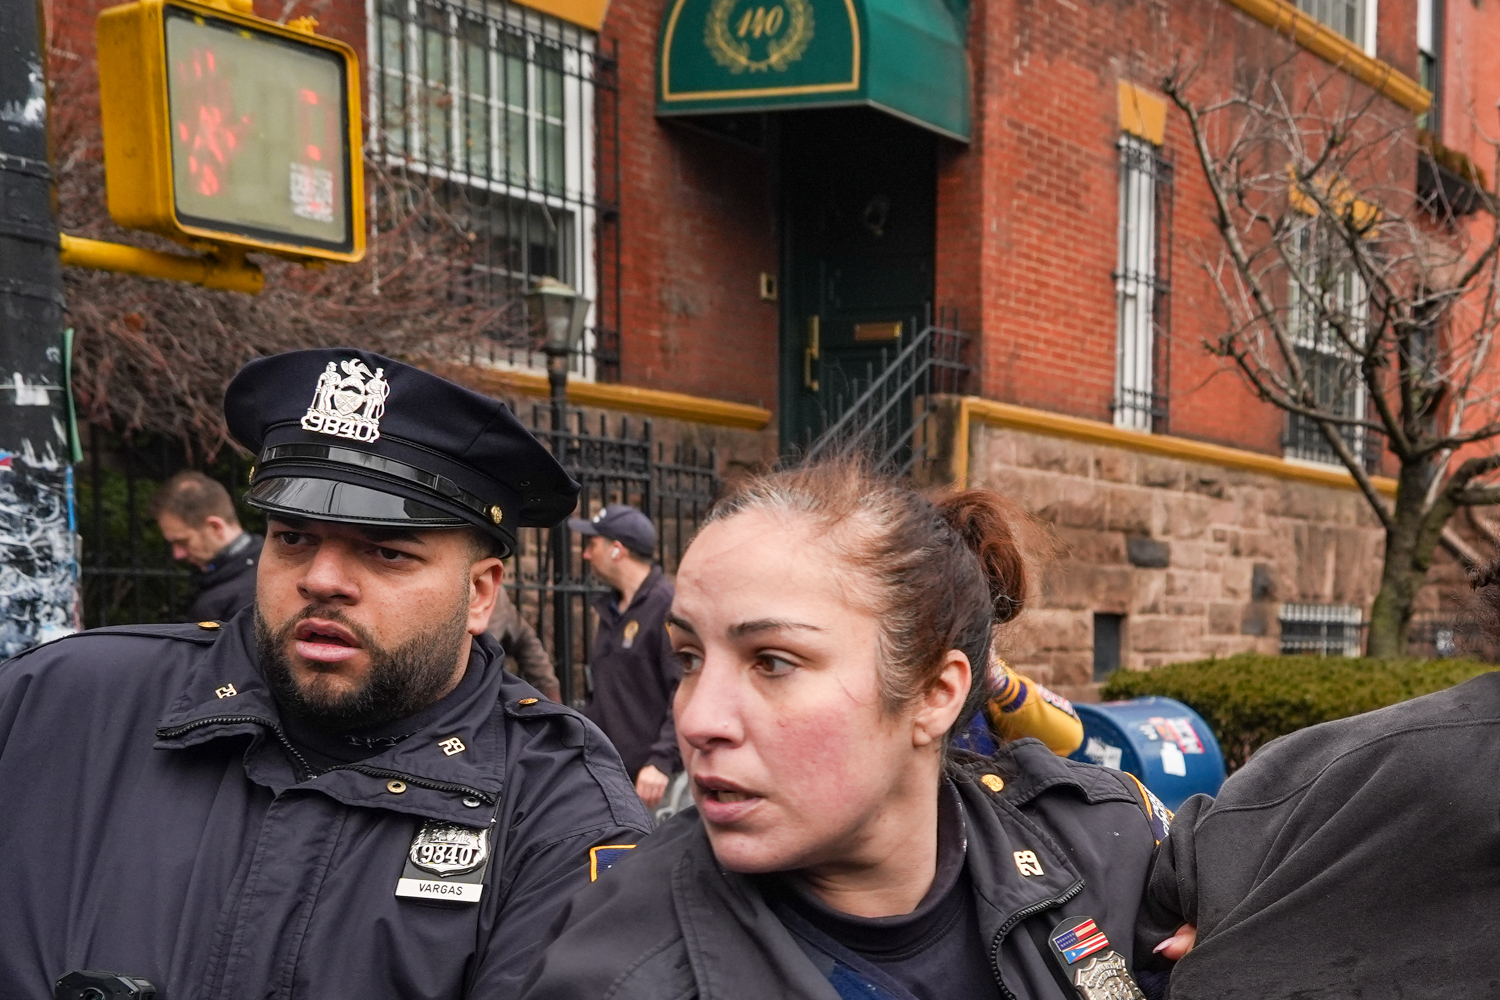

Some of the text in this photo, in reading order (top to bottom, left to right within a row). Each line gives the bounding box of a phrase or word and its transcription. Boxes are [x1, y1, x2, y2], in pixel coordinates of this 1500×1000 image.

[735, 5, 783, 39] 140
[305, 414, 373, 441] 9840
[438, 737, 466, 756] 28
[420, 844, 473, 865] 9840
[1013, 850, 1044, 876] 28
[419, 883, 463, 896] VARGAS
